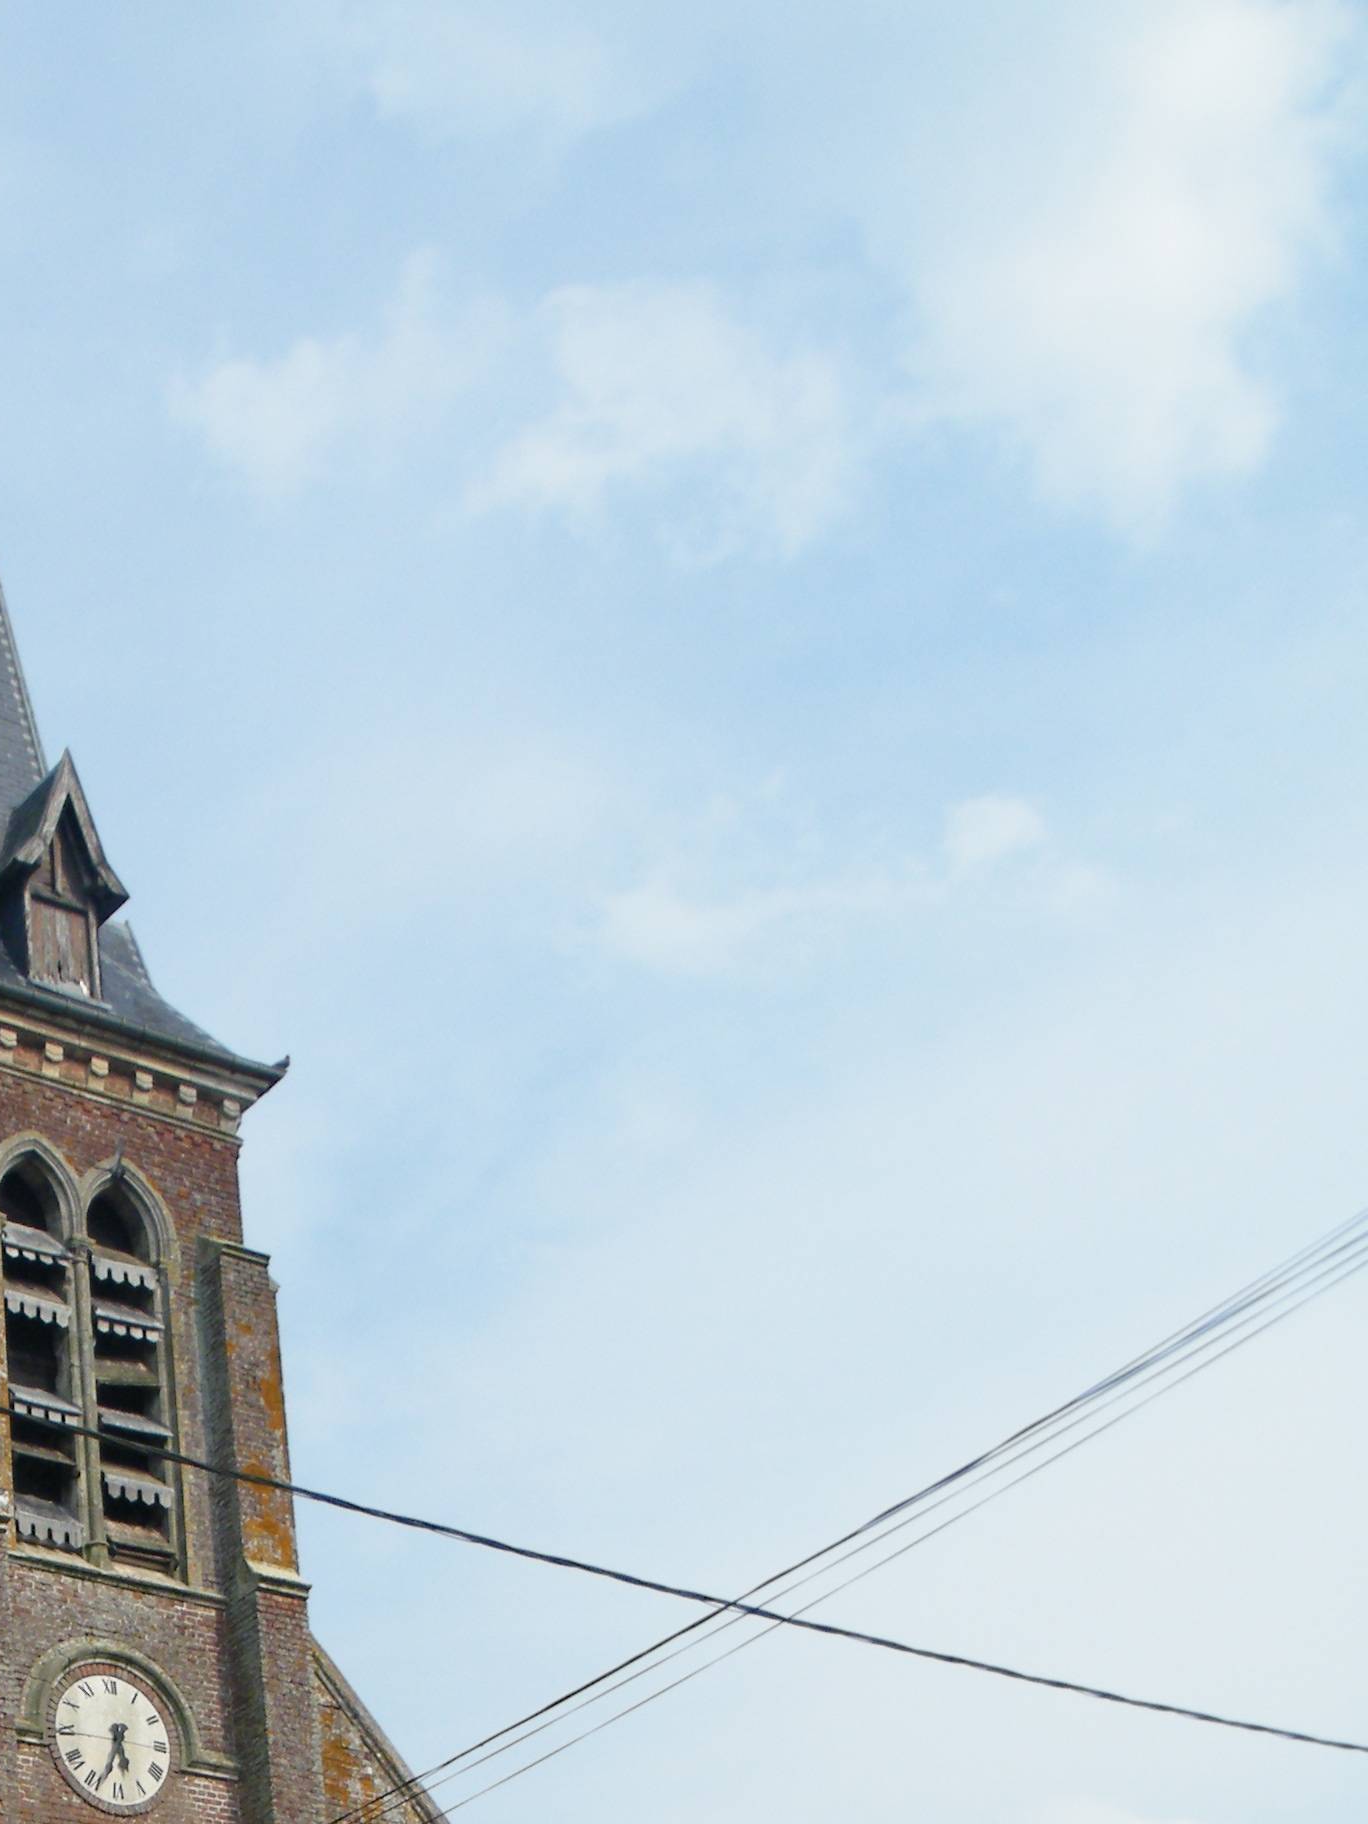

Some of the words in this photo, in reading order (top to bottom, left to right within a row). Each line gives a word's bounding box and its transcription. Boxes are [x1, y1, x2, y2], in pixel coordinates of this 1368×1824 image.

[102, 1679, 117, 1696] XII
[62, 1696, 80, 1712] X
[131, 1692, 138, 1704] I
[146, 1715, 159, 1725] II
[153, 1741, 167, 1753] III
[65, 1749, 85, 1771] VIII
[148, 1761, 164, 1782] IIII
[113, 1782, 124, 1800] VI
[136, 1780, 146, 1797] V
